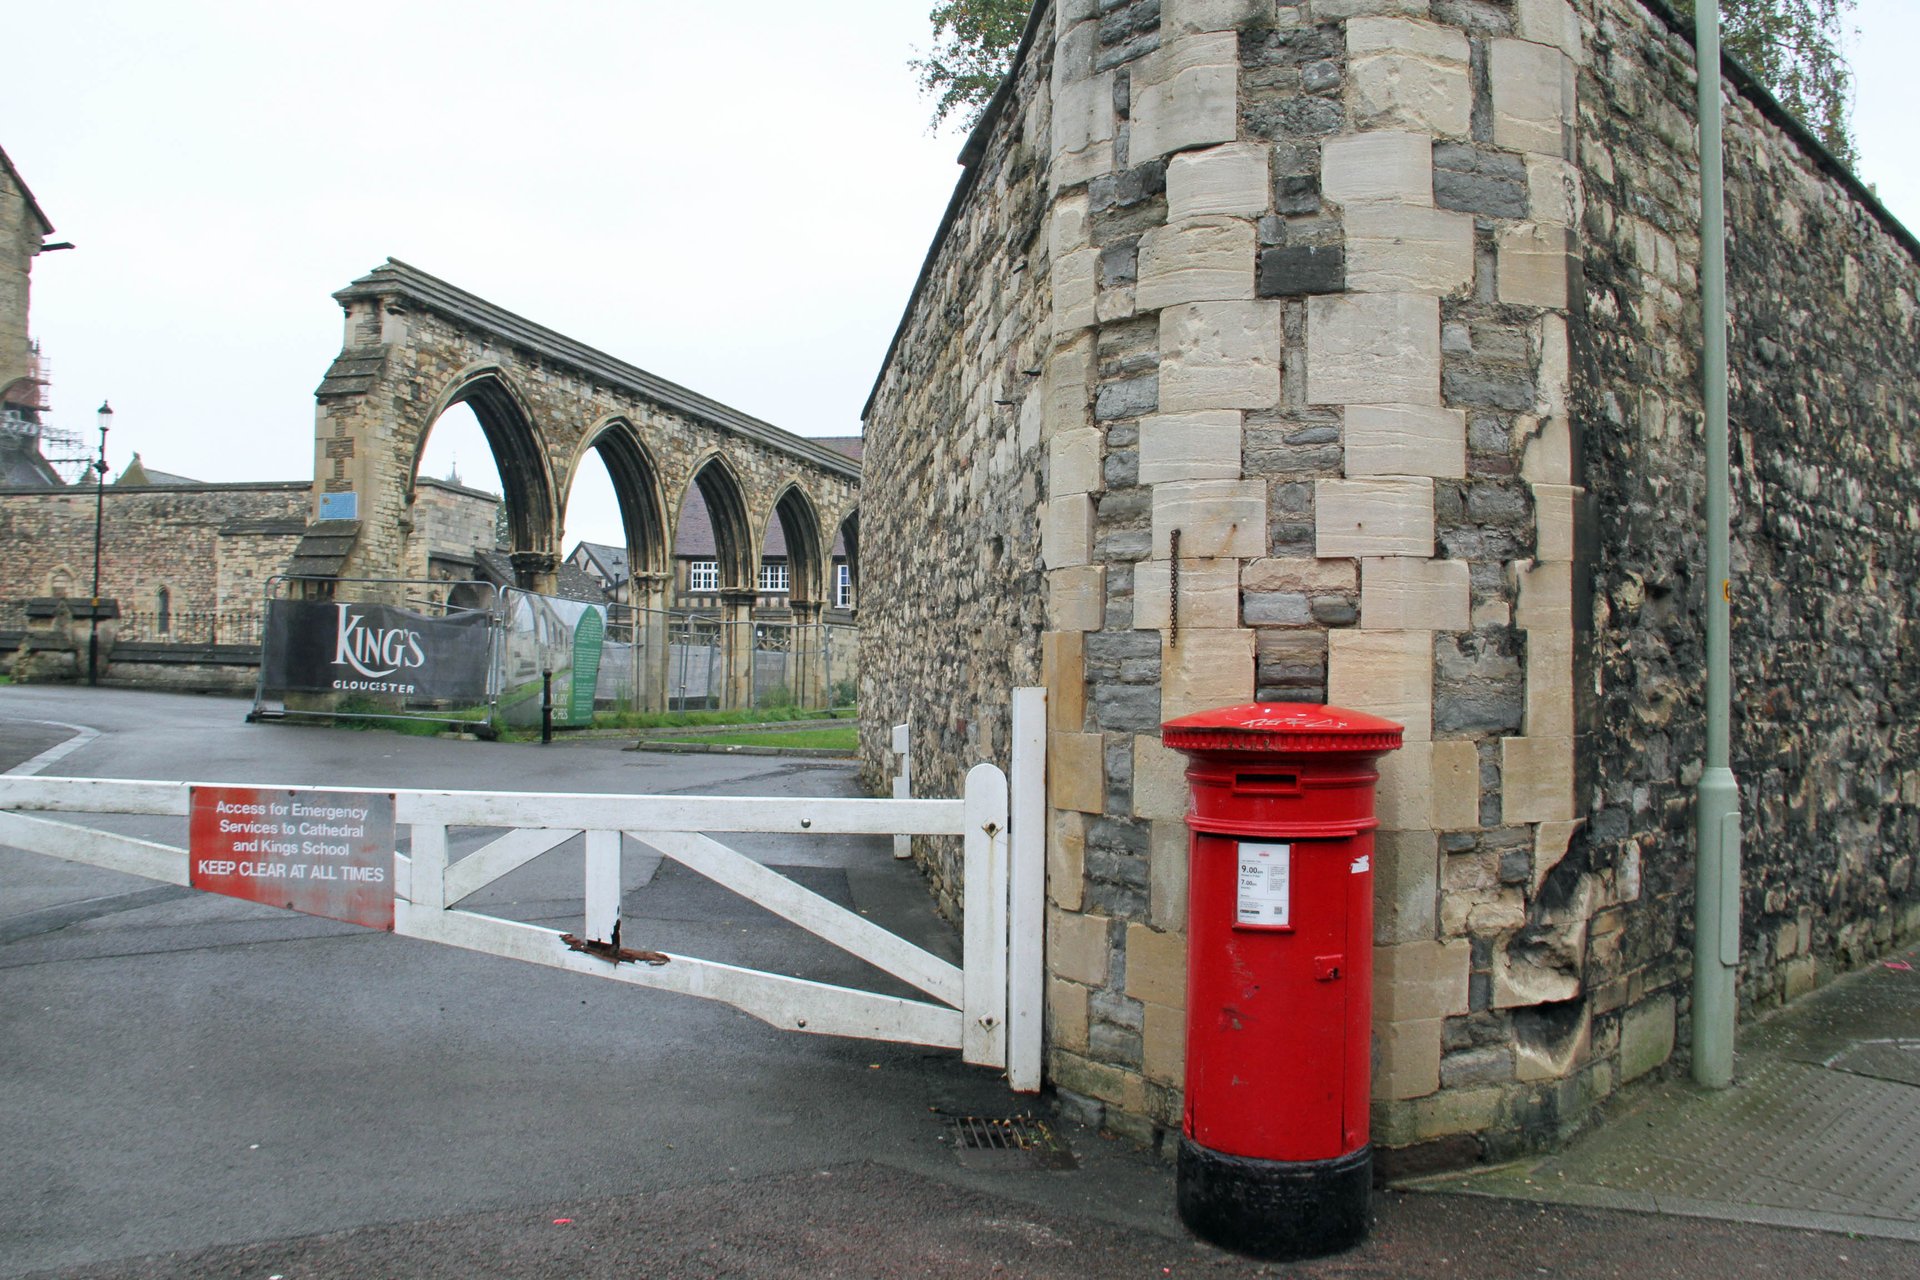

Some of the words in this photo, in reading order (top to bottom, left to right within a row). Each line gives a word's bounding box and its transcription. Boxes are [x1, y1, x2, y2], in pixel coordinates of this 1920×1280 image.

[331, 603, 424, 677] KING'S
[332, 680, 415, 694] GLOUCESTER
[216, 801, 265, 815] Access
[271, 803, 289, 815] for
[292, 803, 368, 820] Emergency
[219, 820, 278, 834] Services
[282, 822, 295, 835] to
[299, 823, 363, 838] Cathedral
[233, 840, 257, 852] and
[262, 840, 298, 855] Kings
[303, 843, 349, 856] School
[199, 860, 236, 875] KEEP
[239, 862, 285, 878] CLEAR
[290, 864, 307, 879] AT
[310, 865, 337, 880] ALL
[341, 867, 384, 882] TIMES
